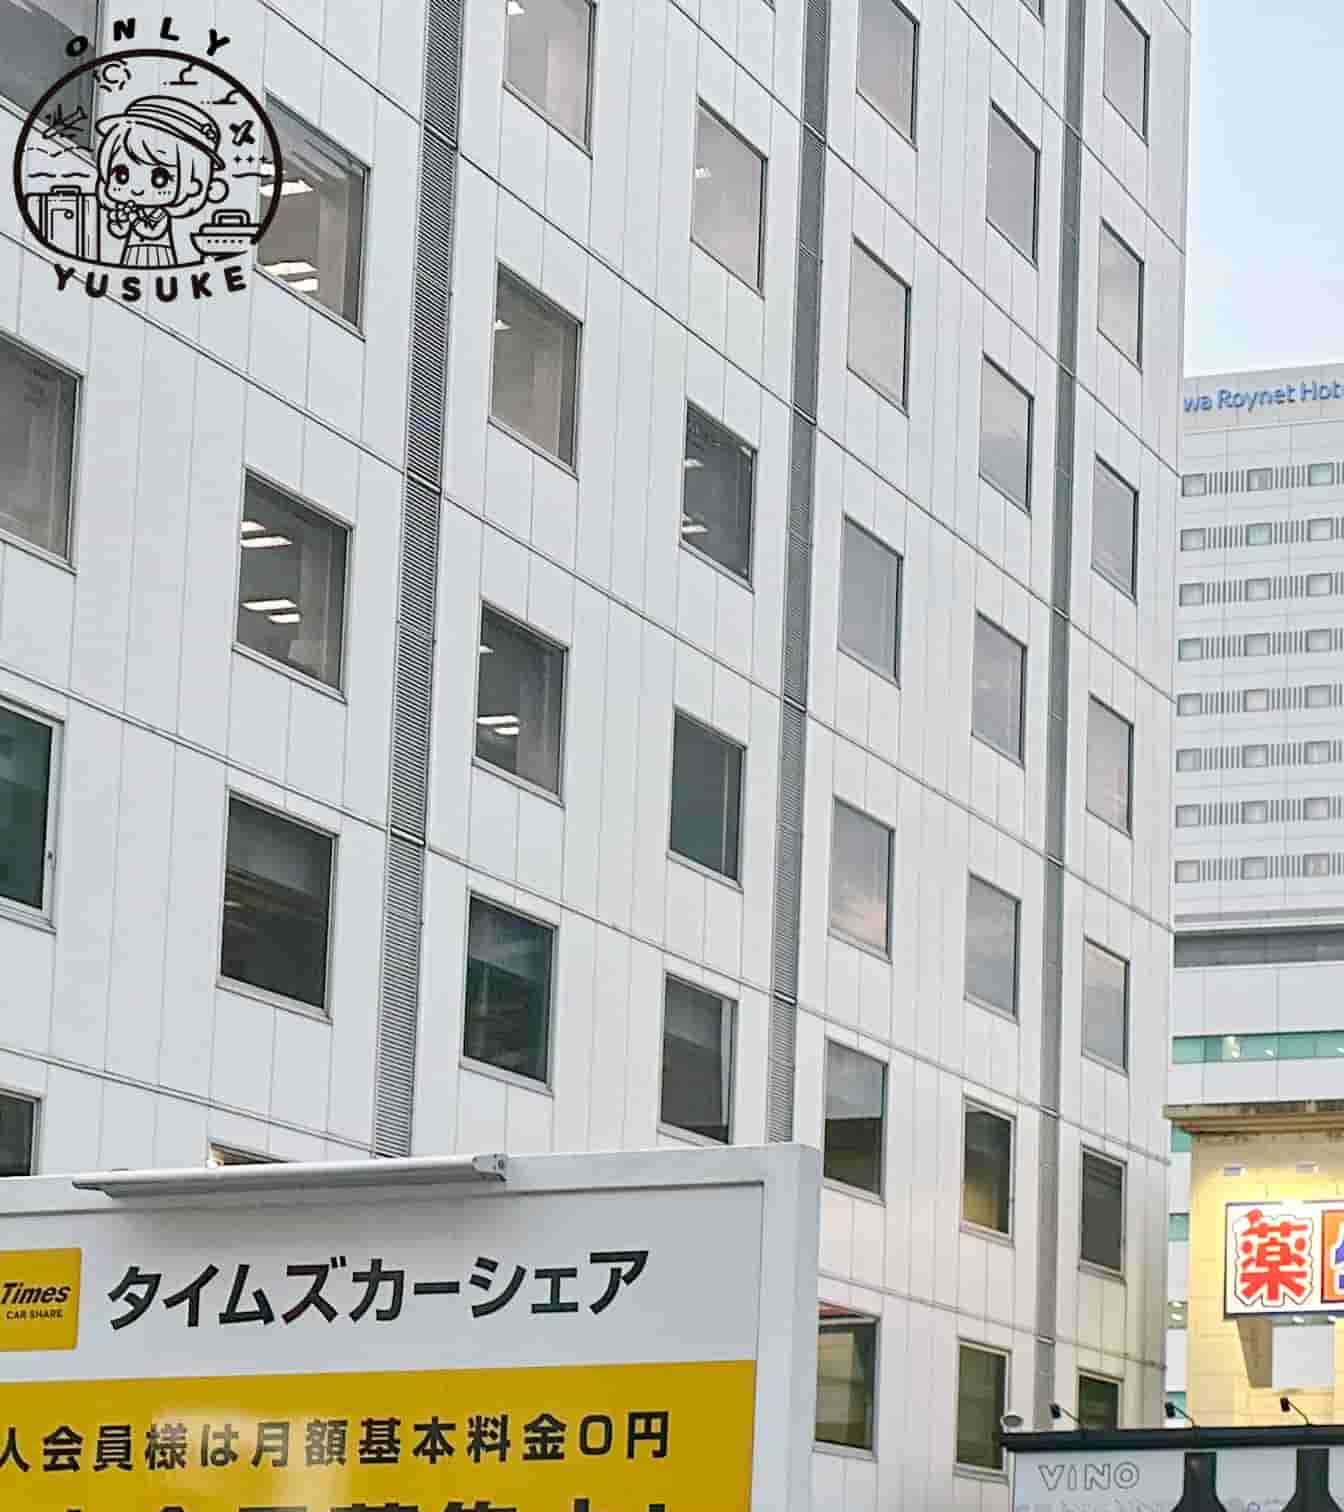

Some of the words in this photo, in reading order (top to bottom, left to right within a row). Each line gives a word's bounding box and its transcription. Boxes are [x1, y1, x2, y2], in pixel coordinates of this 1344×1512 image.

[1216, 383, 1296, 413] Roynet
[1236, 1208, 1310, 1302] 薬
[1, 1281, 72, 1305] Times
[106, 1249, 651, 1332] タイムズカーシェア
[6, 1311, 28, 1320] CAR
[30, 1309, 64, 1319] SHARE
[1038, 1461, 1141, 1491] VINO
